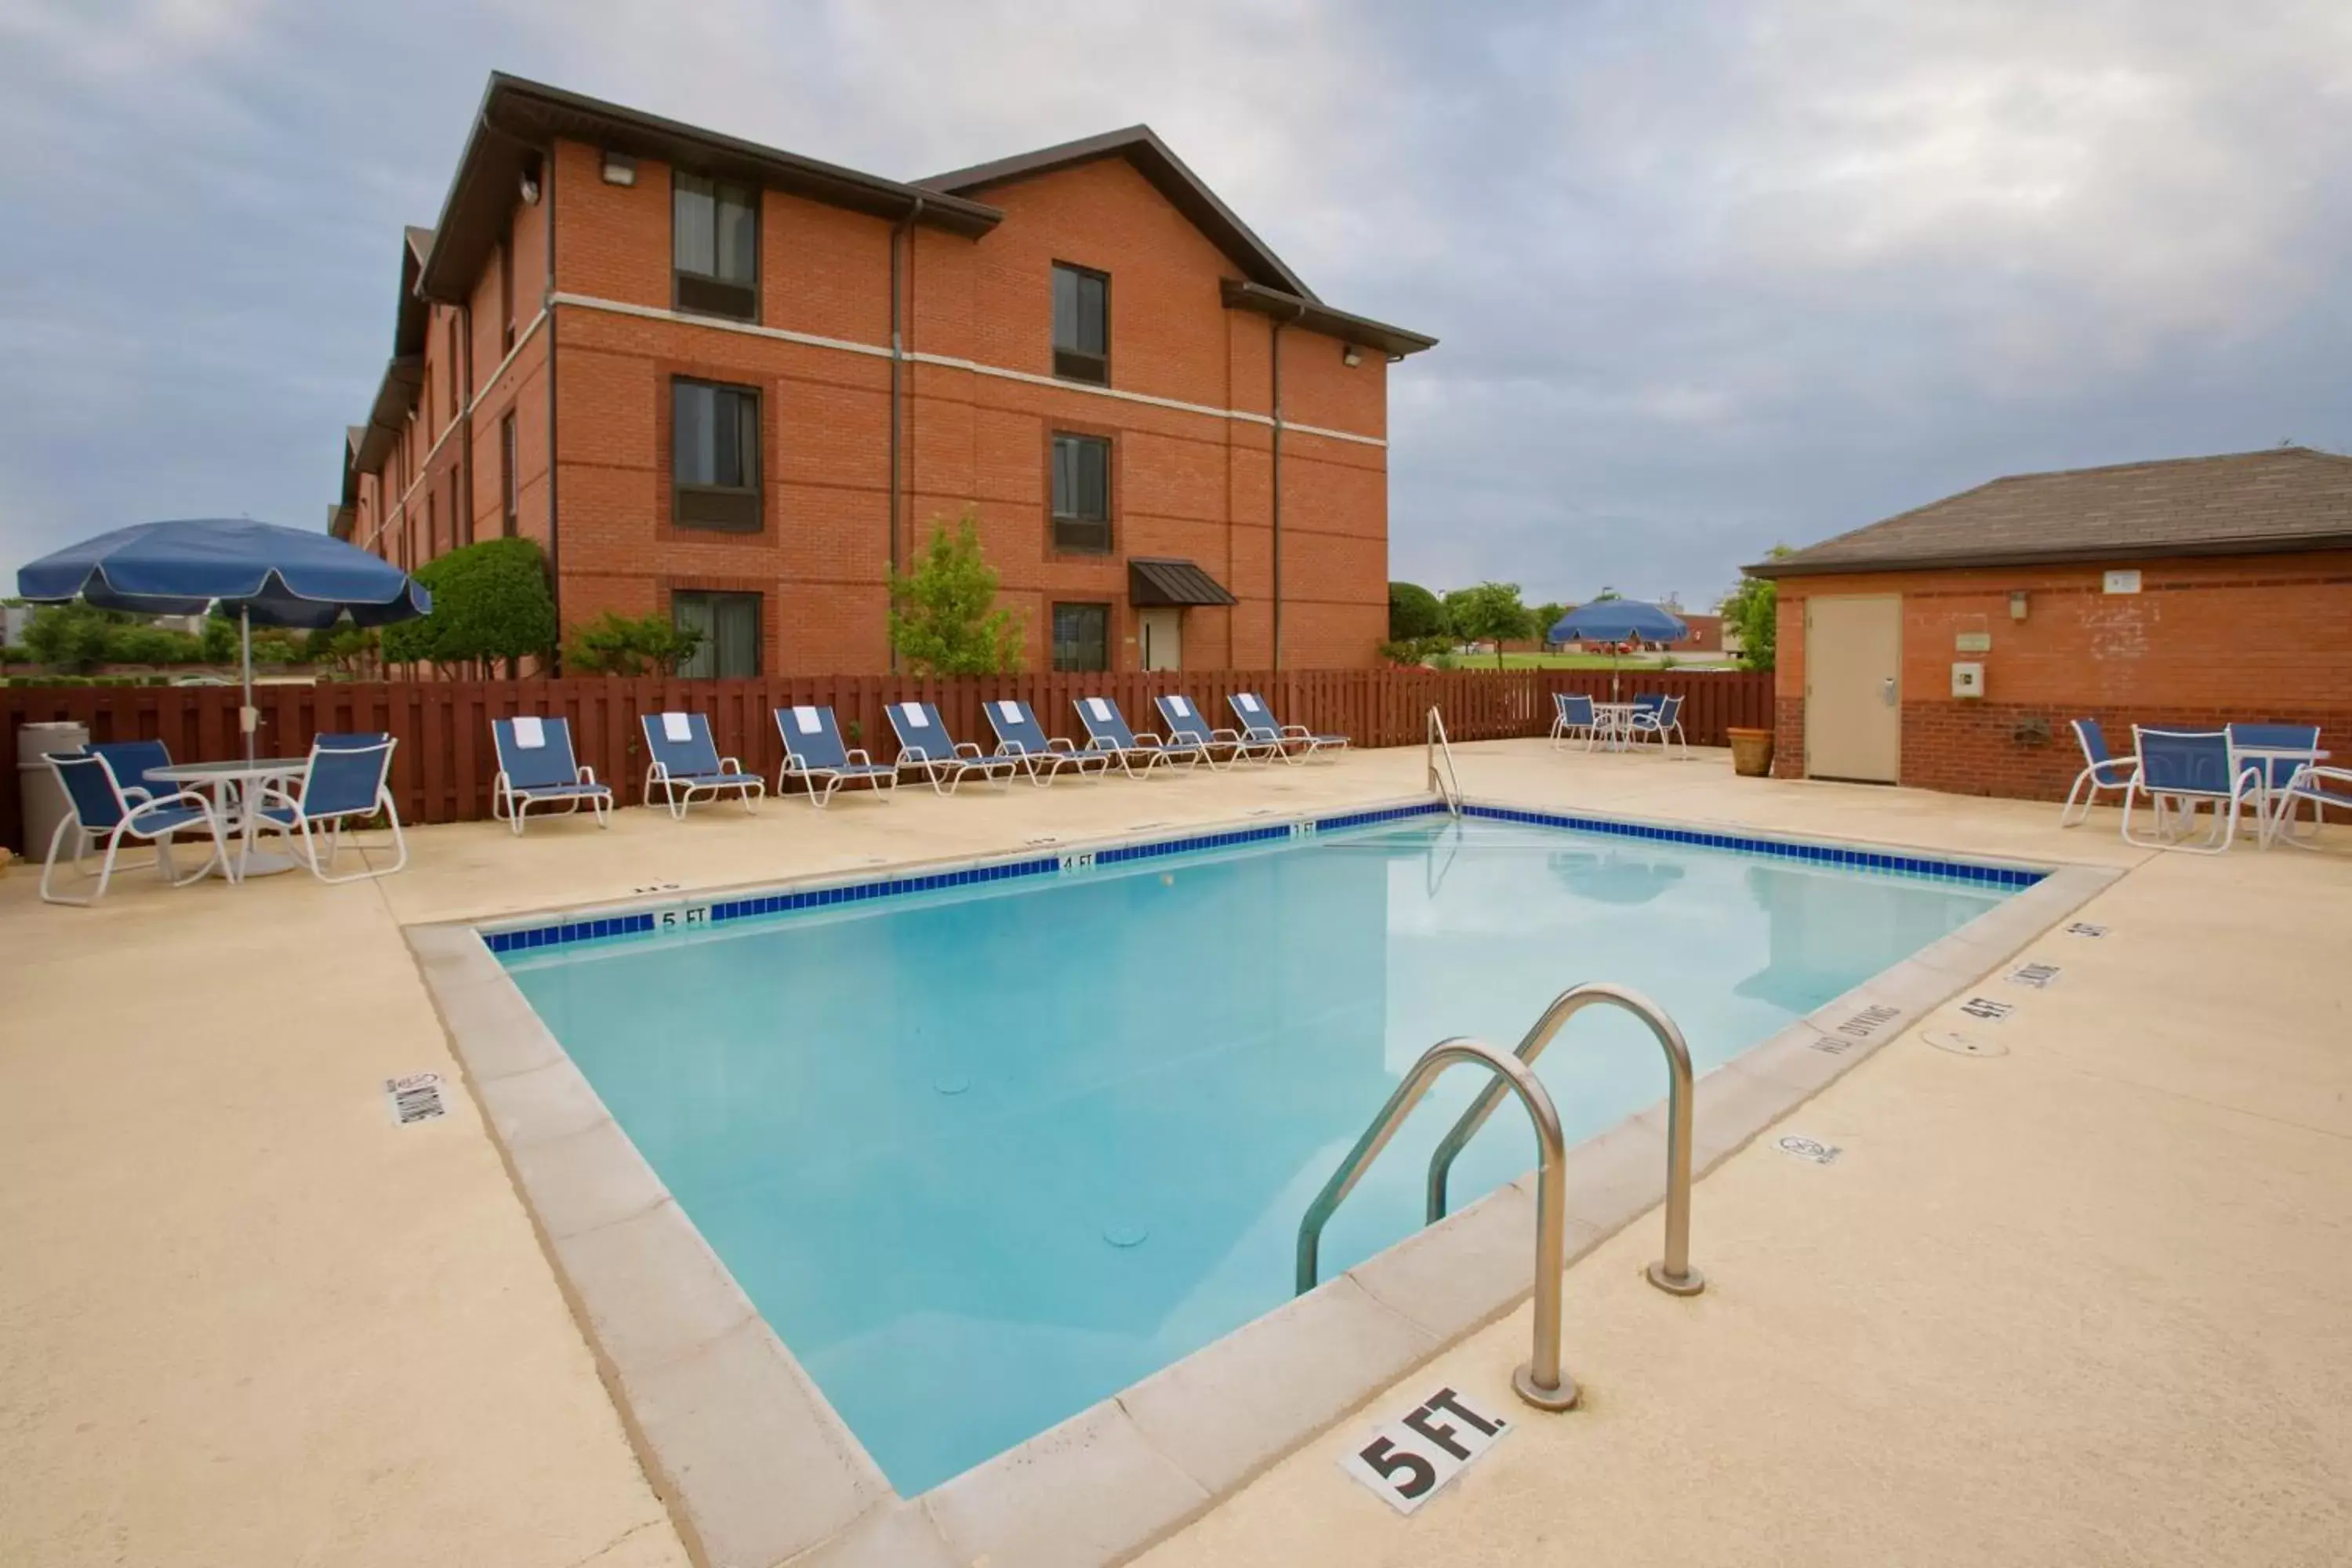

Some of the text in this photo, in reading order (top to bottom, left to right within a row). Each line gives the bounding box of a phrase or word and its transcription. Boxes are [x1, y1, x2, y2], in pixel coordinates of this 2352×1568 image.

[1079, 853, 1092, 867] FT
[662, 906, 707, 927] 5 FT
[1358, 1386, 1508, 1501] 5 FT.
